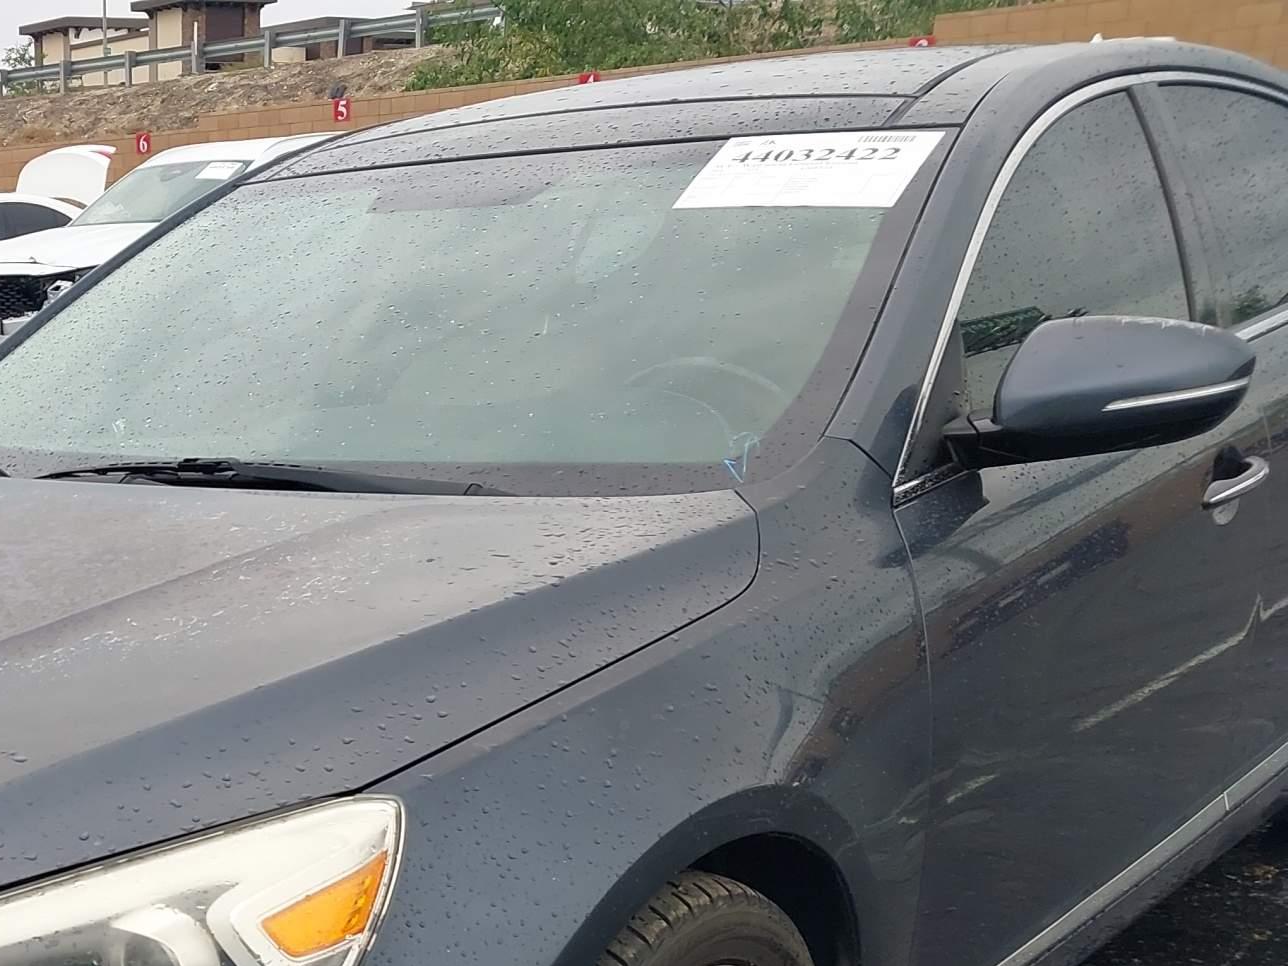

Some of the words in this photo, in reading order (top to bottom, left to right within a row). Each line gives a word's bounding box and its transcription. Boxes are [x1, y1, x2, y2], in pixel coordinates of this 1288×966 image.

[336, 100, 348, 120] 5
[138, 136, 148, 153] 6
[731, 147, 902, 163] 44032422
